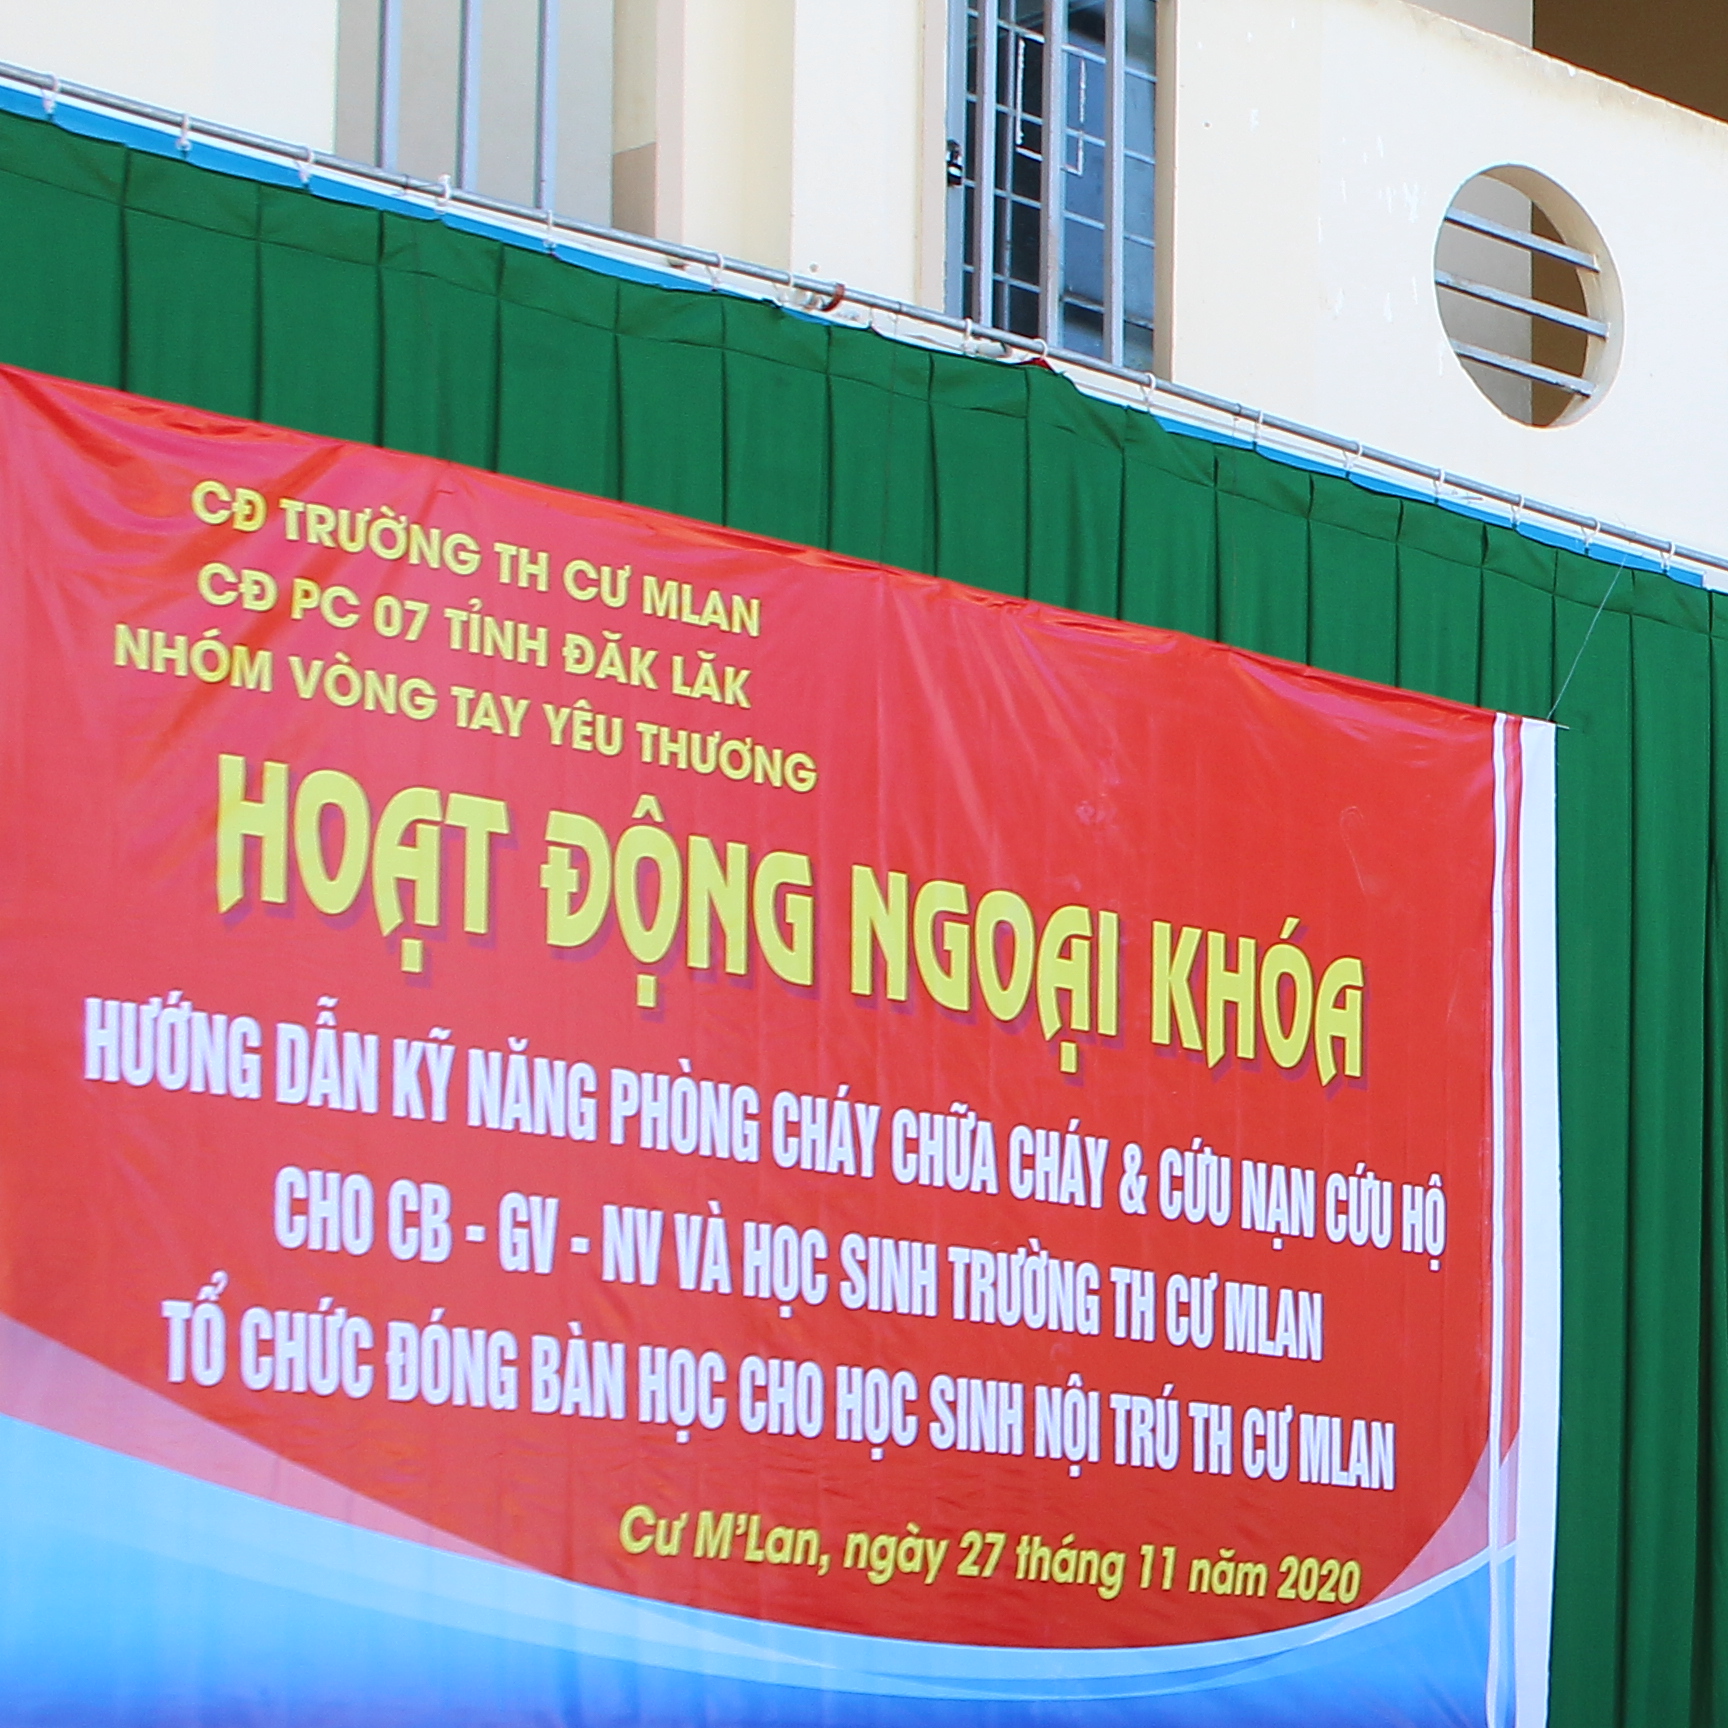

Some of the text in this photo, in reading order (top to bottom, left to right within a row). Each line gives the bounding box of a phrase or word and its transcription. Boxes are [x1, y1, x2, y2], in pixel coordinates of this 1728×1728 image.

[191, 480, 761, 638] CĐ TRƯỜNG TH CƯ MLAN
[198, 562, 278, 613] CĐ
[290, 578, 359, 628] PC
[373, 599, 429, 642] 07
[444, 598, 549, 668] TỈNH
[671, 651, 752, 708] LĂK
[113, 624, 817, 794] NHÓM VÒNG TAY YÊU THƯƠNG
[217, 754, 1365, 1087] HOẠT ĐỘNG NGOẠI KHÓA
[84, 990, 1448, 1272] HƯỚNG DẪN KỸ NĂNG PHÒNG CHÁY CHỮA CHÁY & CỨU NẠN CỨU HỘ
[274, 1165, 1325, 1362] CHO CB - GV - NV VÀ HỌC SINH TRƯỜNG TH CƯ MLAN
[160, 1270, 1396, 1491] TỔ CHỨC ĐÓNG BÀN HỌC CHO HỌC SINH NỘI TRÚ TH CƯ MLAN
[619, 1504, 690, 1556] Cư
[842, 1521, 949, 1585] ngày
[956, 1530, 1006, 1579] 27
[1015, 1532, 1127, 1601] tháng
[1140, 1544, 1178, 1591] 11
[1188, 1548, 1268, 1598] năm
[1277, 1555, 1361, 1605] 2020
